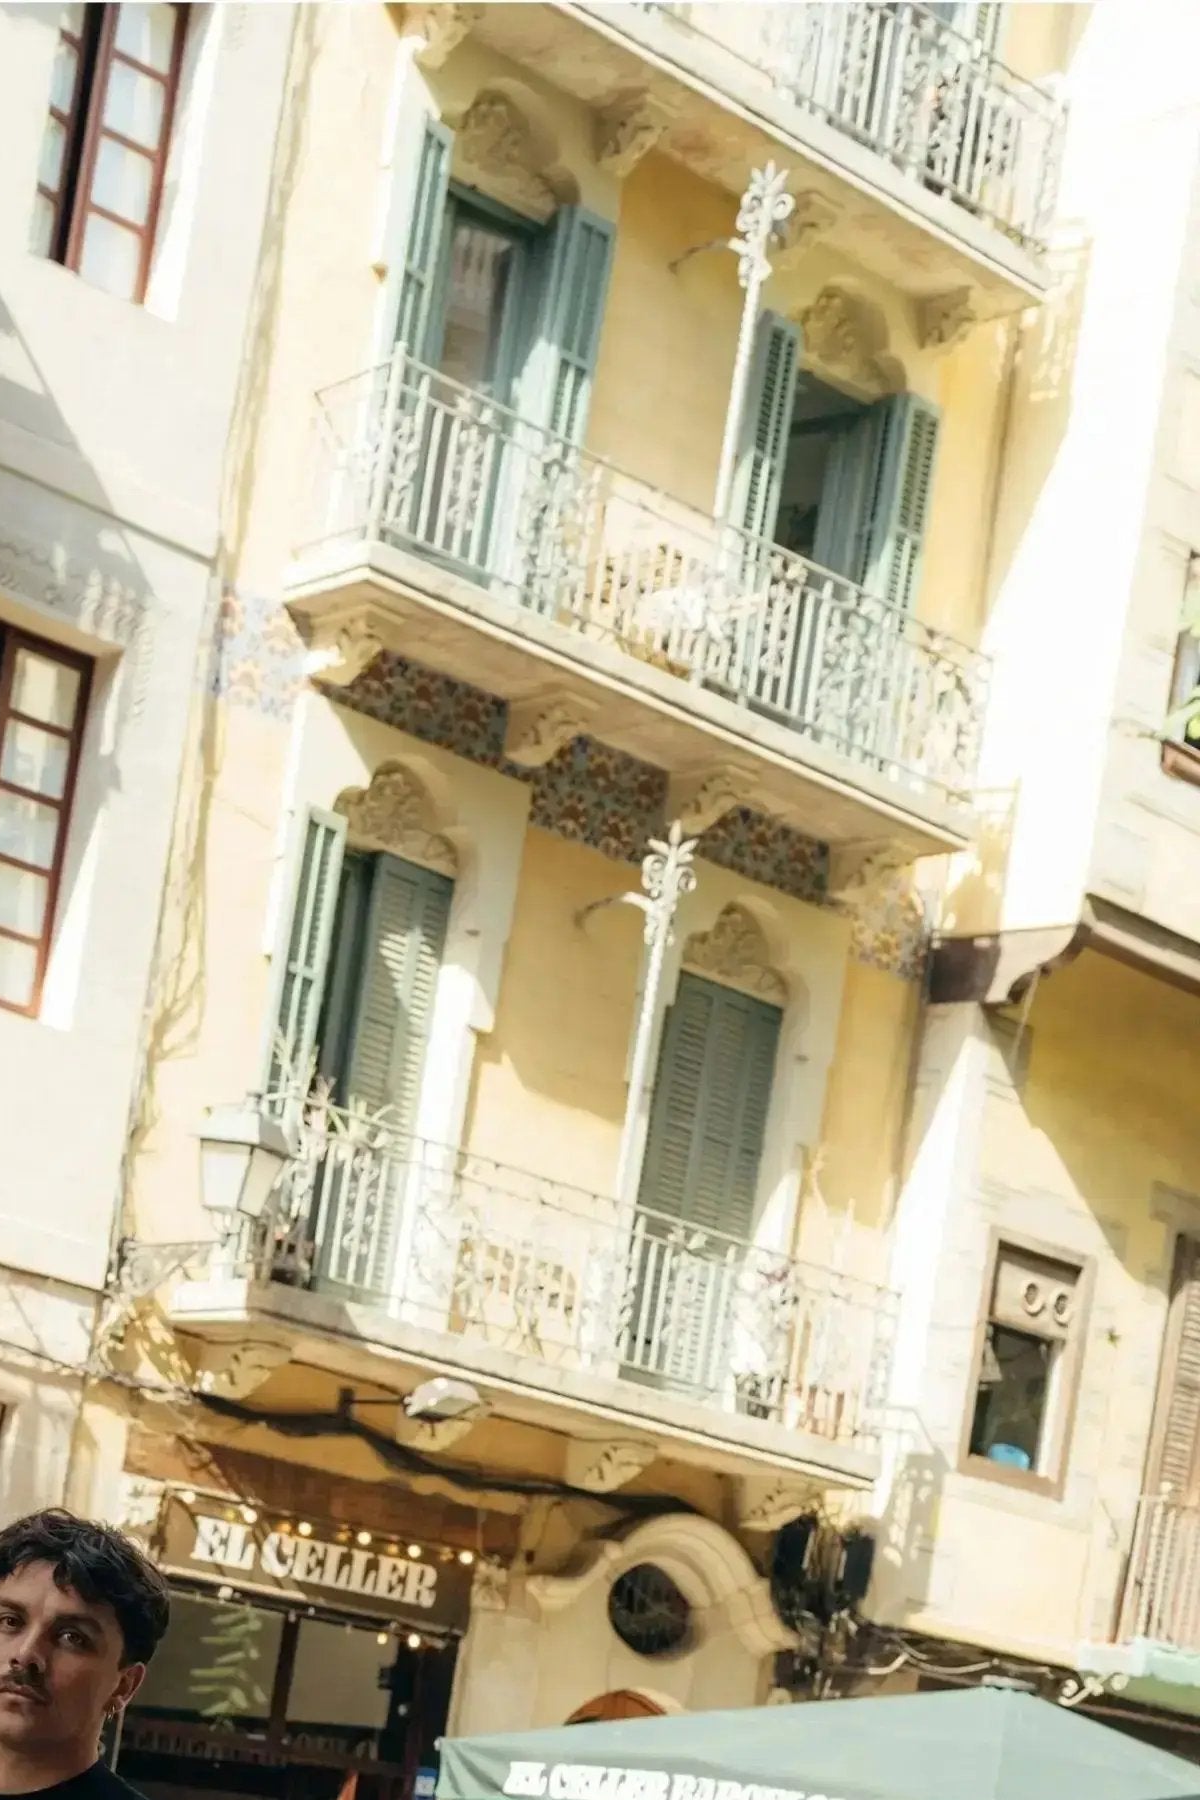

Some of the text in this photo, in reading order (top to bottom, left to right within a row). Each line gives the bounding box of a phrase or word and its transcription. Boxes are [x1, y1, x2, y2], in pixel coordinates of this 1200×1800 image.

[189, 1514, 439, 1609] EL CELLER
[502, 1760, 548, 1797] EL
